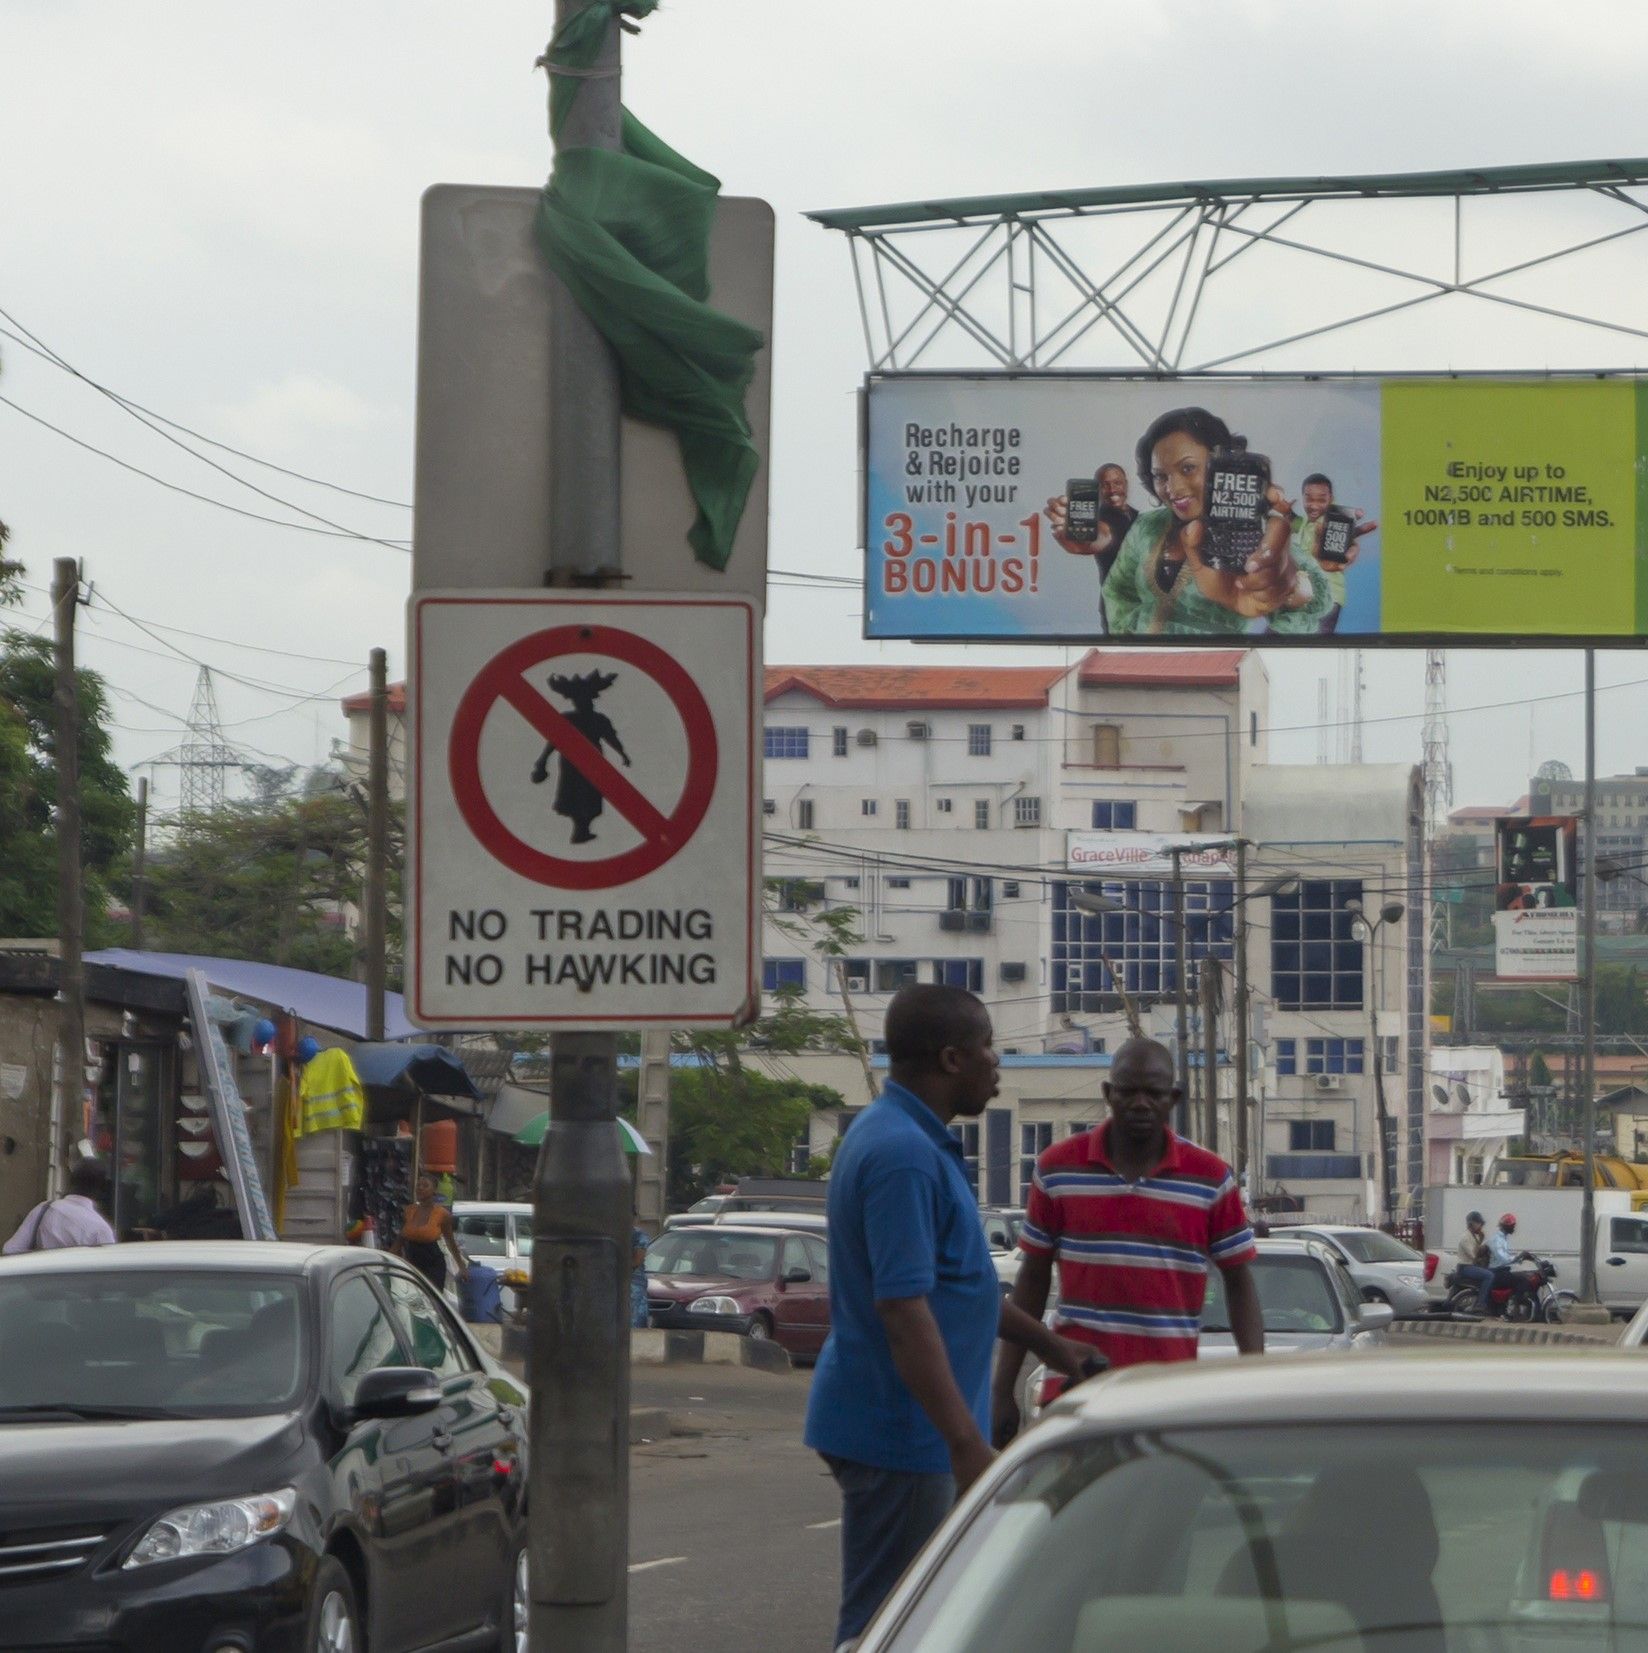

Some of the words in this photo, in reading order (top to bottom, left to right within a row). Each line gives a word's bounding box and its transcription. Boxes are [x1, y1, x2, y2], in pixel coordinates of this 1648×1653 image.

[905, 423, 1021, 449] Recharge
[905, 453, 923, 475] &
[928, 451, 1021, 481] Rejoice
[1451, 461, 1507, 486] Enjoy
[1514, 467, 1539, 486] up
[1546, 462, 1565, 479] to
[1213, 472, 1258, 492] FREE
[905, 481, 957, 504] with
[966, 484, 1018, 508] your
[1500, 486, 1593, 506] AIRTIME,
[1069, 501, 1096, 511] FREE
[1209, 506, 1256, 520] AIRTIME
[1328, 521, 1350, 533] FREE
[1404, 510, 1471, 526] 100MB
[1478, 510, 1514, 527] and
[1521, 511, 1556, 527] 500
[1563, 511, 1614, 527] SMS.
[883, 512, 1041, 559] 3-in-1
[1323, 540, 1346, 553] SMS
[1325, 530, 1347, 543] 500
[884, 558, 1039, 594] BONUS!
[449, 909, 507, 941] NO
[530, 909, 712, 941] TRADING
[445, 954, 503, 985] NO
[525, 954, 716, 985] HAWKING
